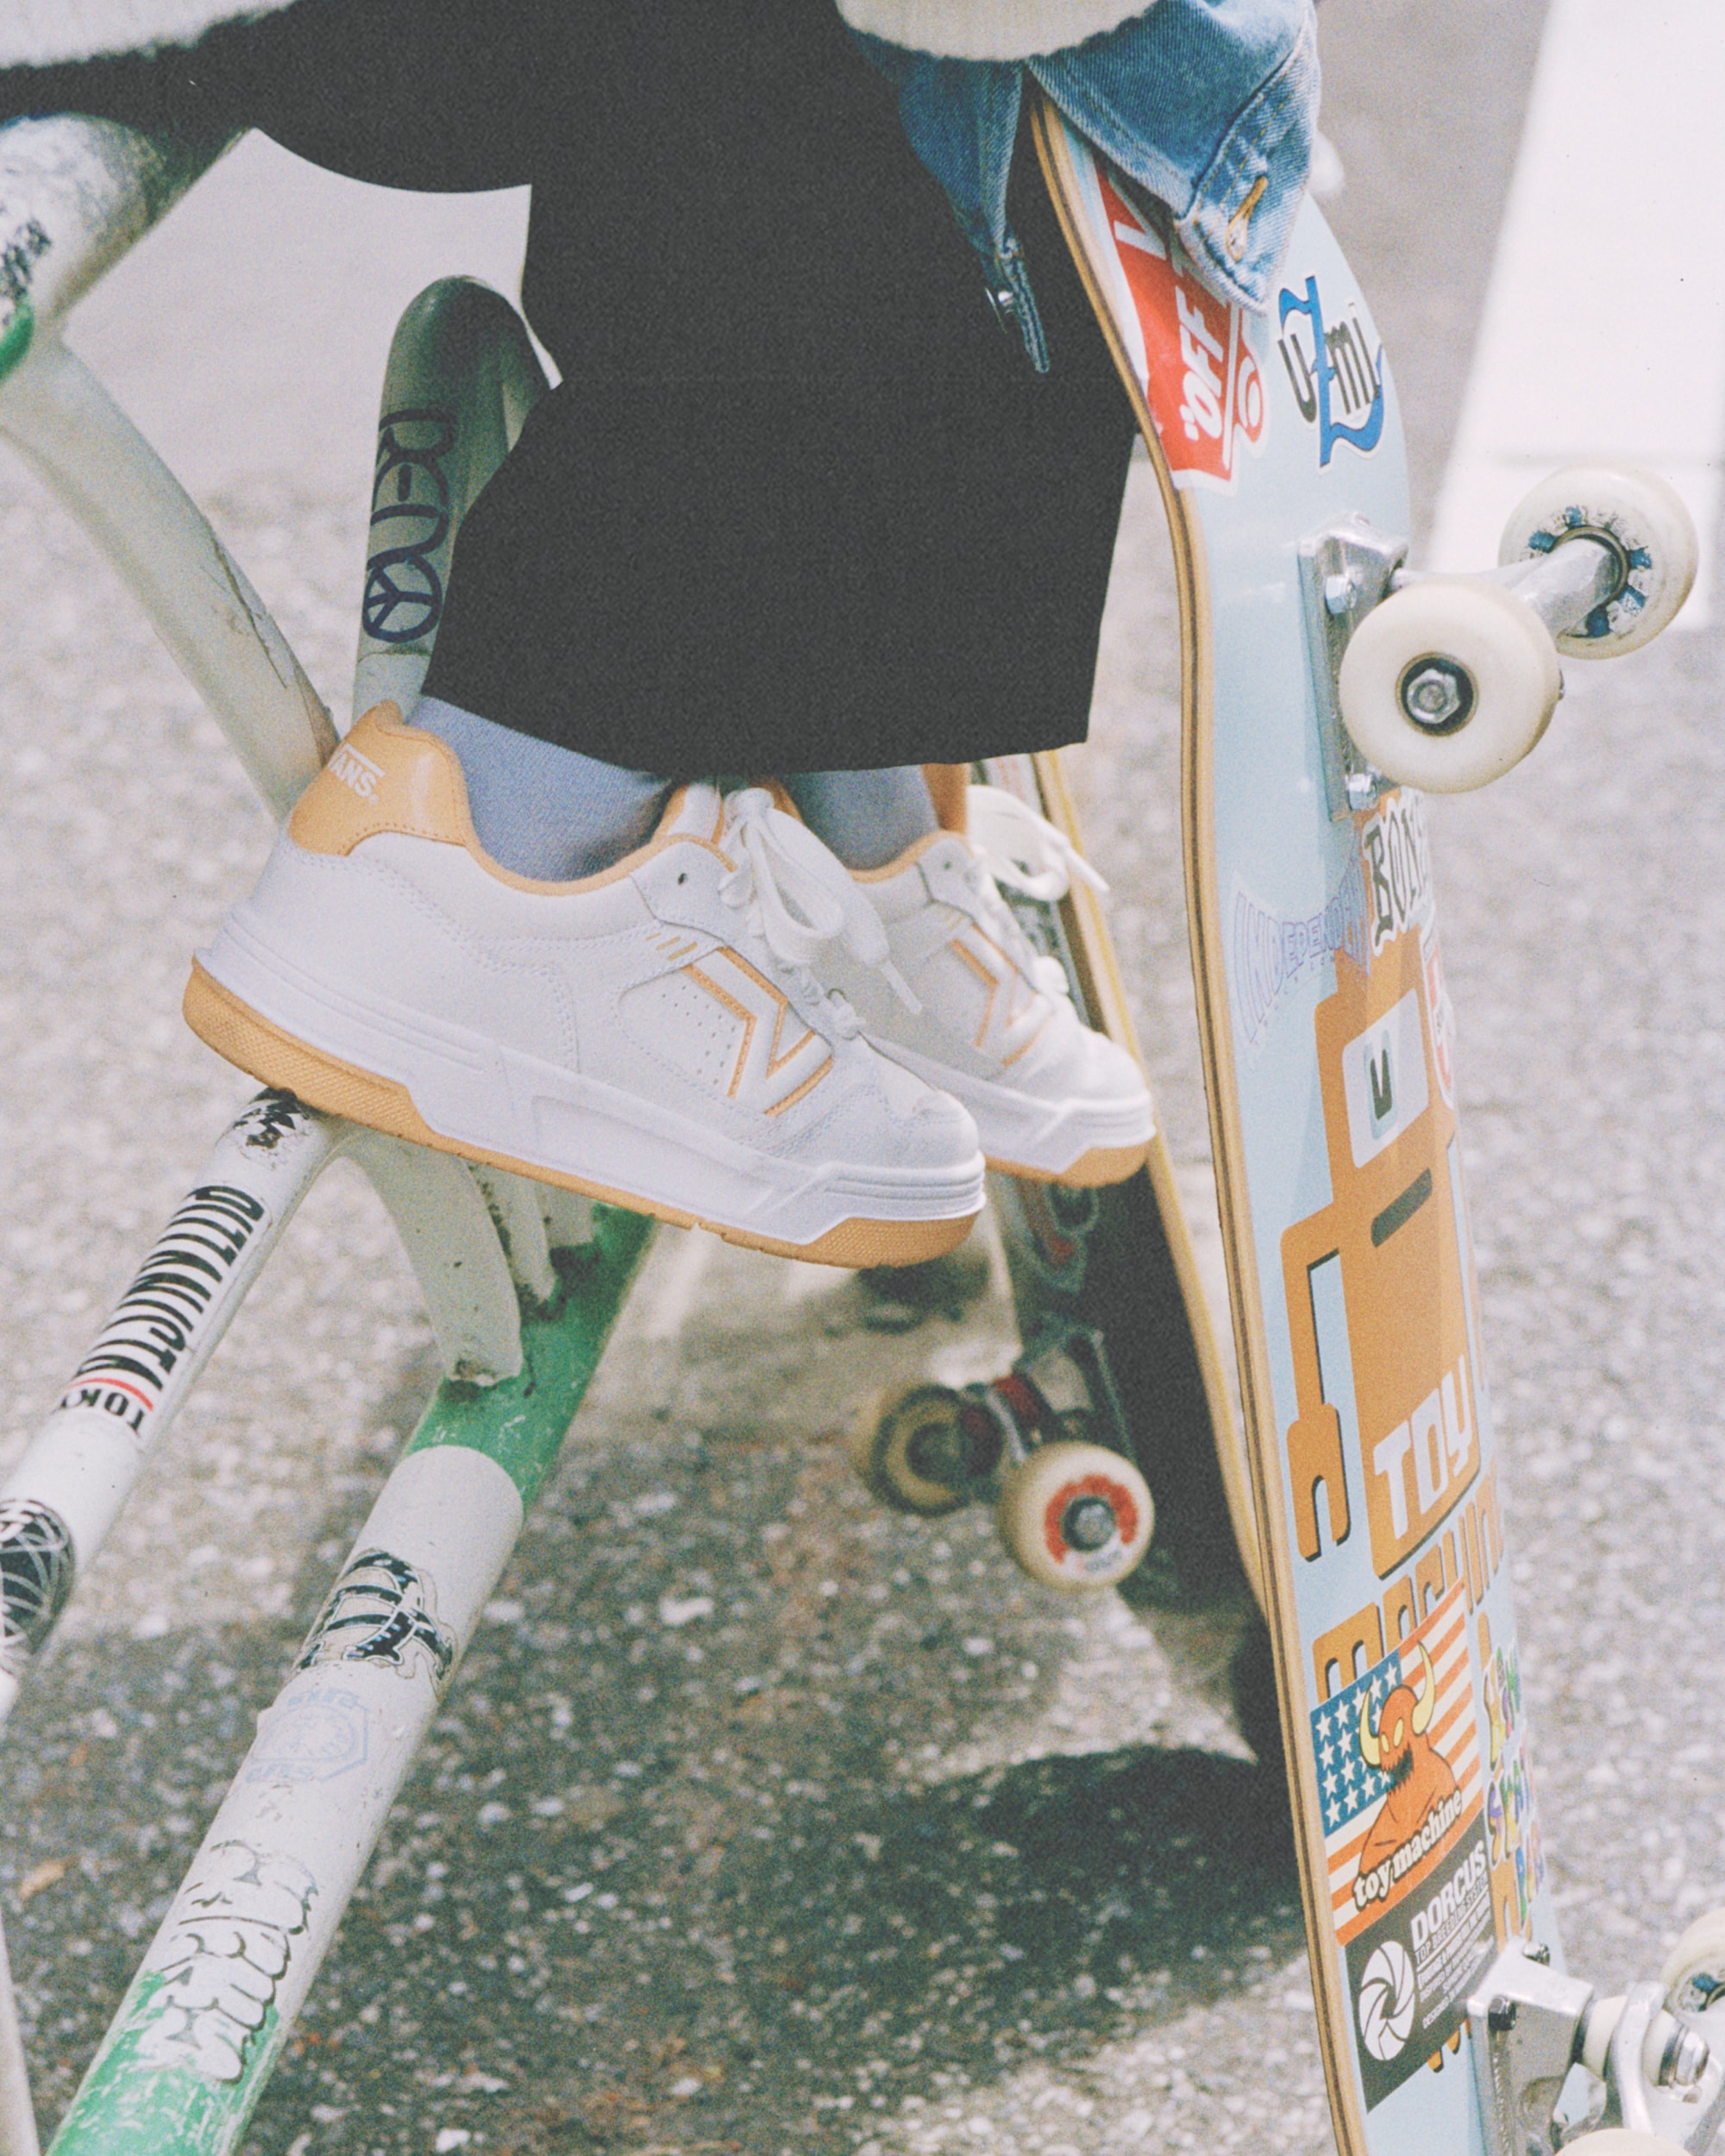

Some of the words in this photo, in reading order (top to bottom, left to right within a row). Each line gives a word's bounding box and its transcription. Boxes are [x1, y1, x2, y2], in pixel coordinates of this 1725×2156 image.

[53, 1388, 146, 1438] TOK
[1353, 1858, 1393, 1908] toy
[1391, 1788, 1462, 1880] machine
[1410, 1839, 1487, 1951] DORCUS
